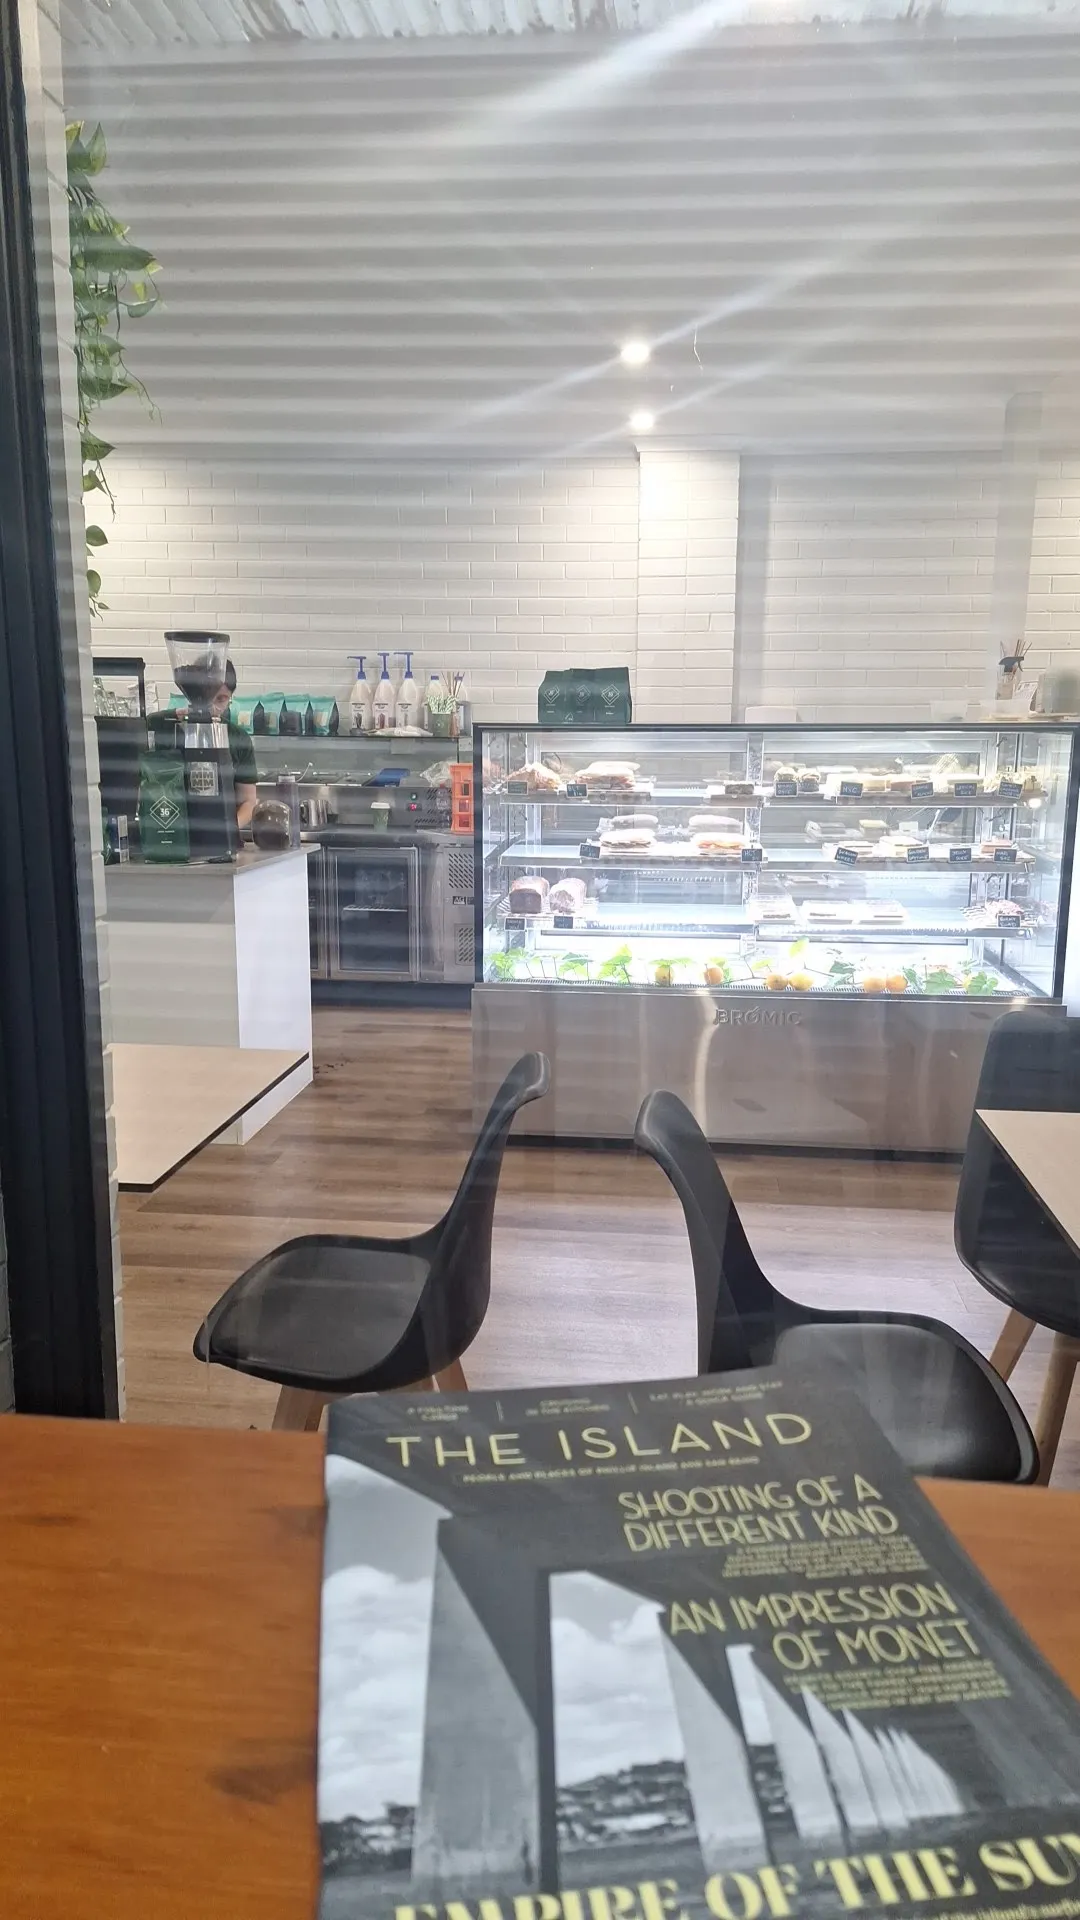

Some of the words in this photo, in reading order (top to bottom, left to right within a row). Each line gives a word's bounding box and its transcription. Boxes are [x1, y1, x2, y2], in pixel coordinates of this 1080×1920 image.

[386, 1433, 527, 1468] THE
[558, 1412, 813, 1461] ISLAND
[618, 1480, 796, 1521] SHOOTING
[796, 1474, 845, 1508] OF
[853, 1472, 883, 1502] A
[622, 1509, 806, 1552] DIFFERENT
[811, 1503, 899, 1539] KIND
[669, 1597, 727, 1636] AN
[729, 1580, 959, 1631] IMPRESSION
[771, 1628, 831, 1671] OF
[834, 1617, 980, 1666] MONET
[704, 1863, 800, 1920] OF
[813, 1847, 977, 1910] THE
